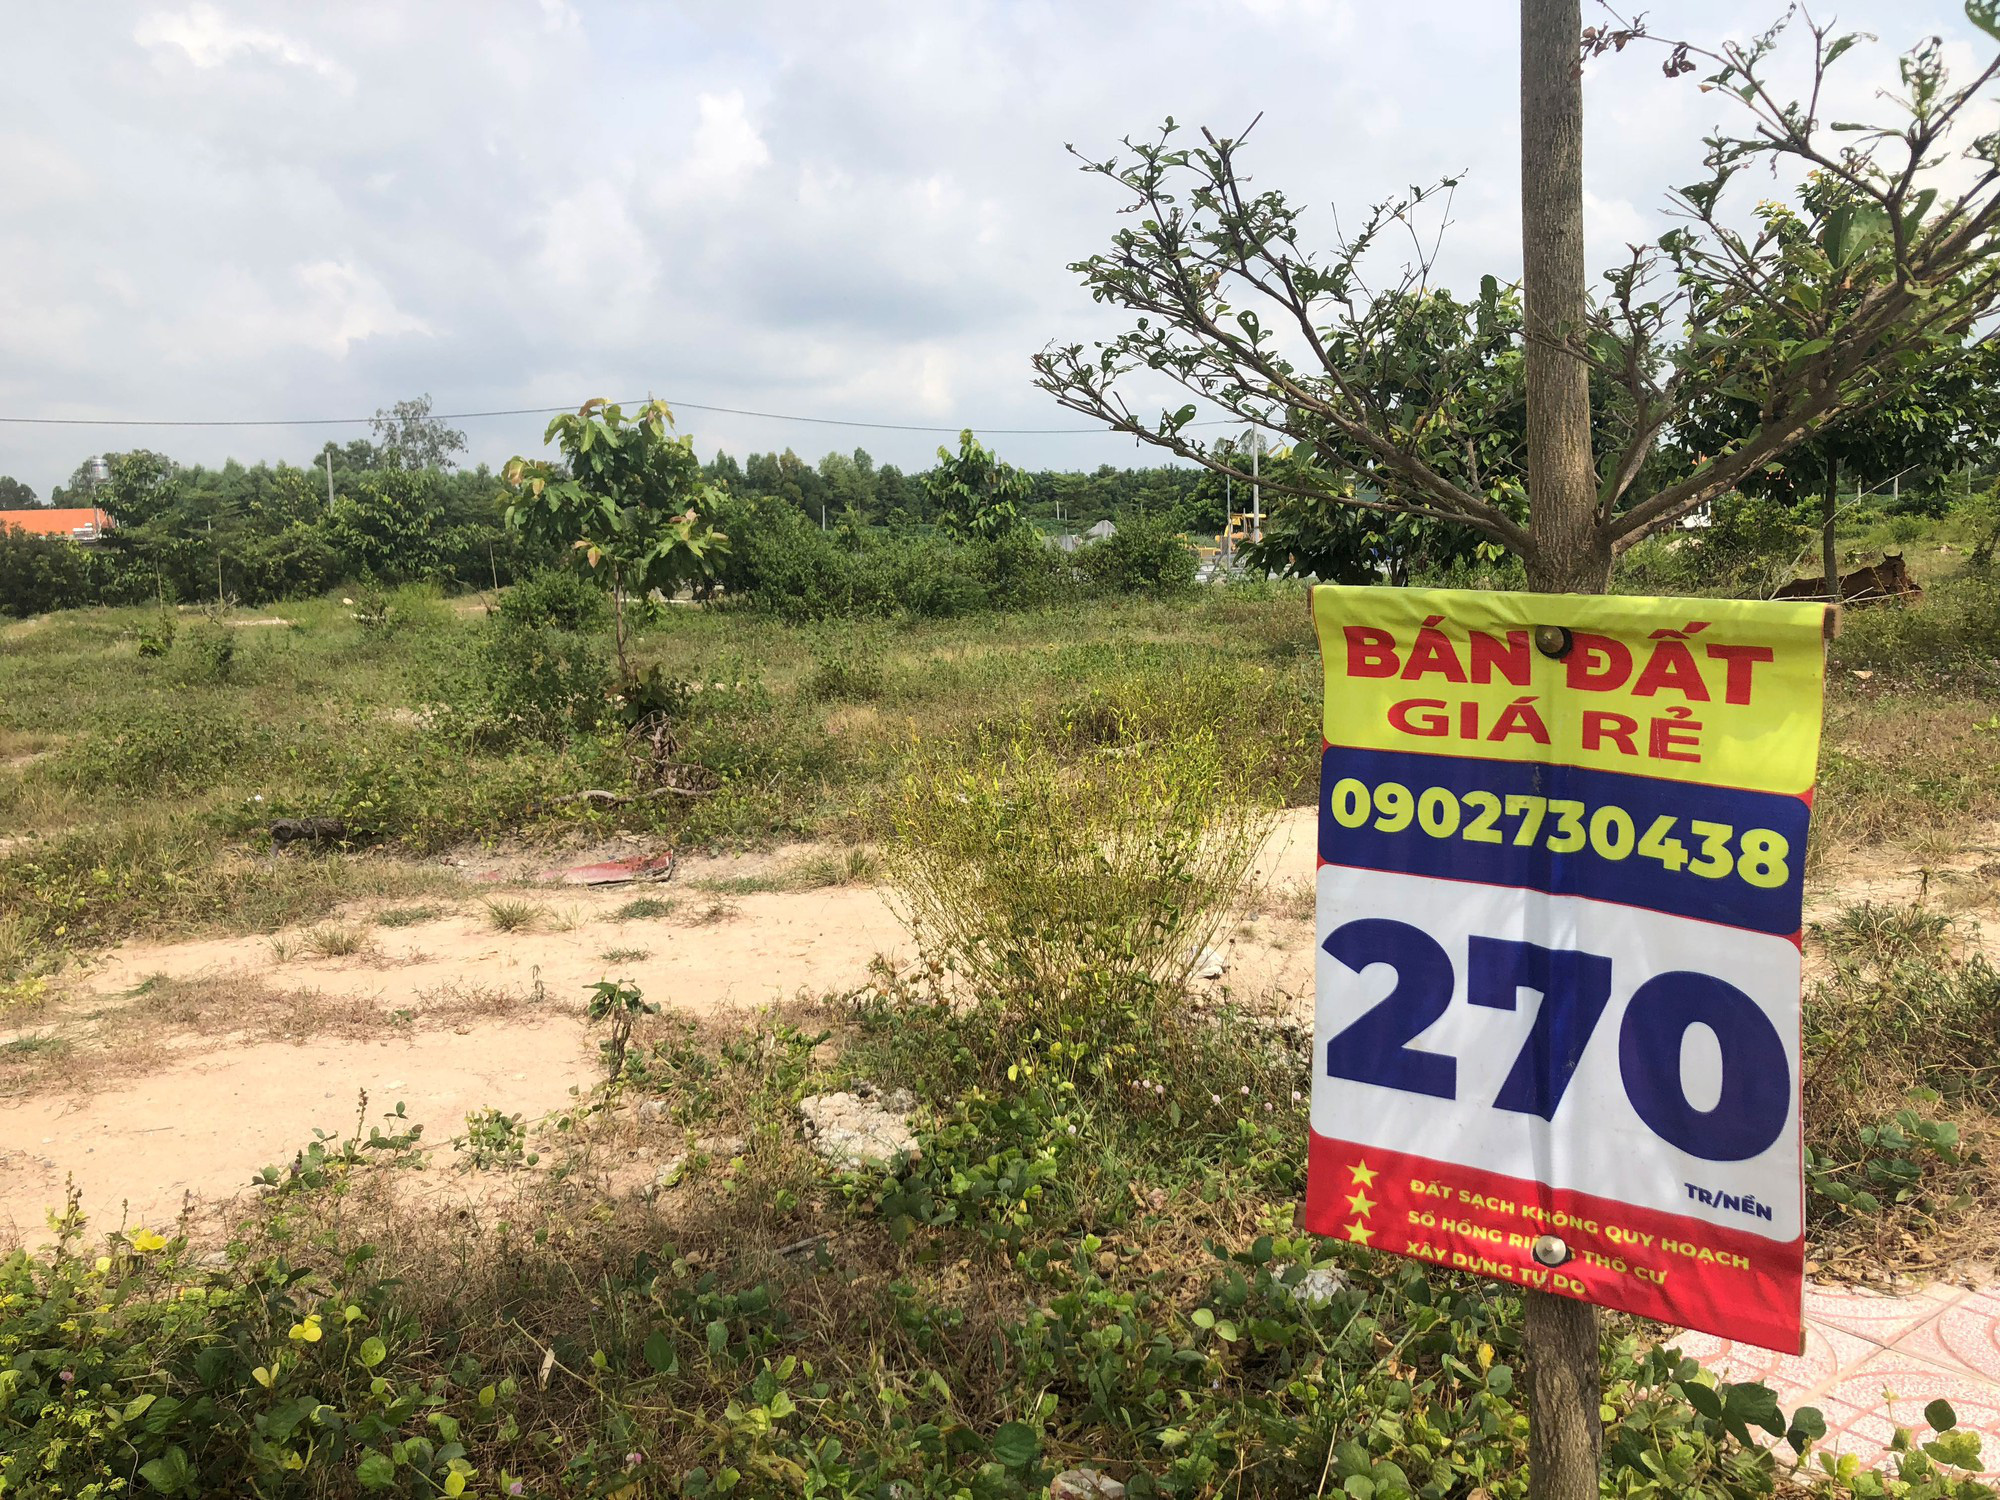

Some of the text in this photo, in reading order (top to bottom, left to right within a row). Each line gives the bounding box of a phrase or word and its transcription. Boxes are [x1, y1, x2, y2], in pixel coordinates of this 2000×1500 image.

[1343, 615, 1774, 705] BÁN ĐẤT
[1387, 696, 1703, 763] GIÁ RẺ
[1331, 778, 1790, 888] 0902730438
[1321, 918, 1791, 1162] 270
[1410, 1179, 1453, 1199] ĐẤT
[1458, 1190, 1515, 1214] SẠCH
[1521, 1205, 1599, 1234] KHÔNG
[1604, 1225, 1654, 1247] QUY
[1661, 1238, 1750, 1270] HOẠCH
[1684, 1182, 1772, 1222] TR/NỀN
[1406, 1240, 1447, 1262] XÂY
[1553, 1273, 1586, 1295] DO
[1441, 1217, 1503, 1243] HỒNG
[1634, 1266, 1668, 1285] CƯ
